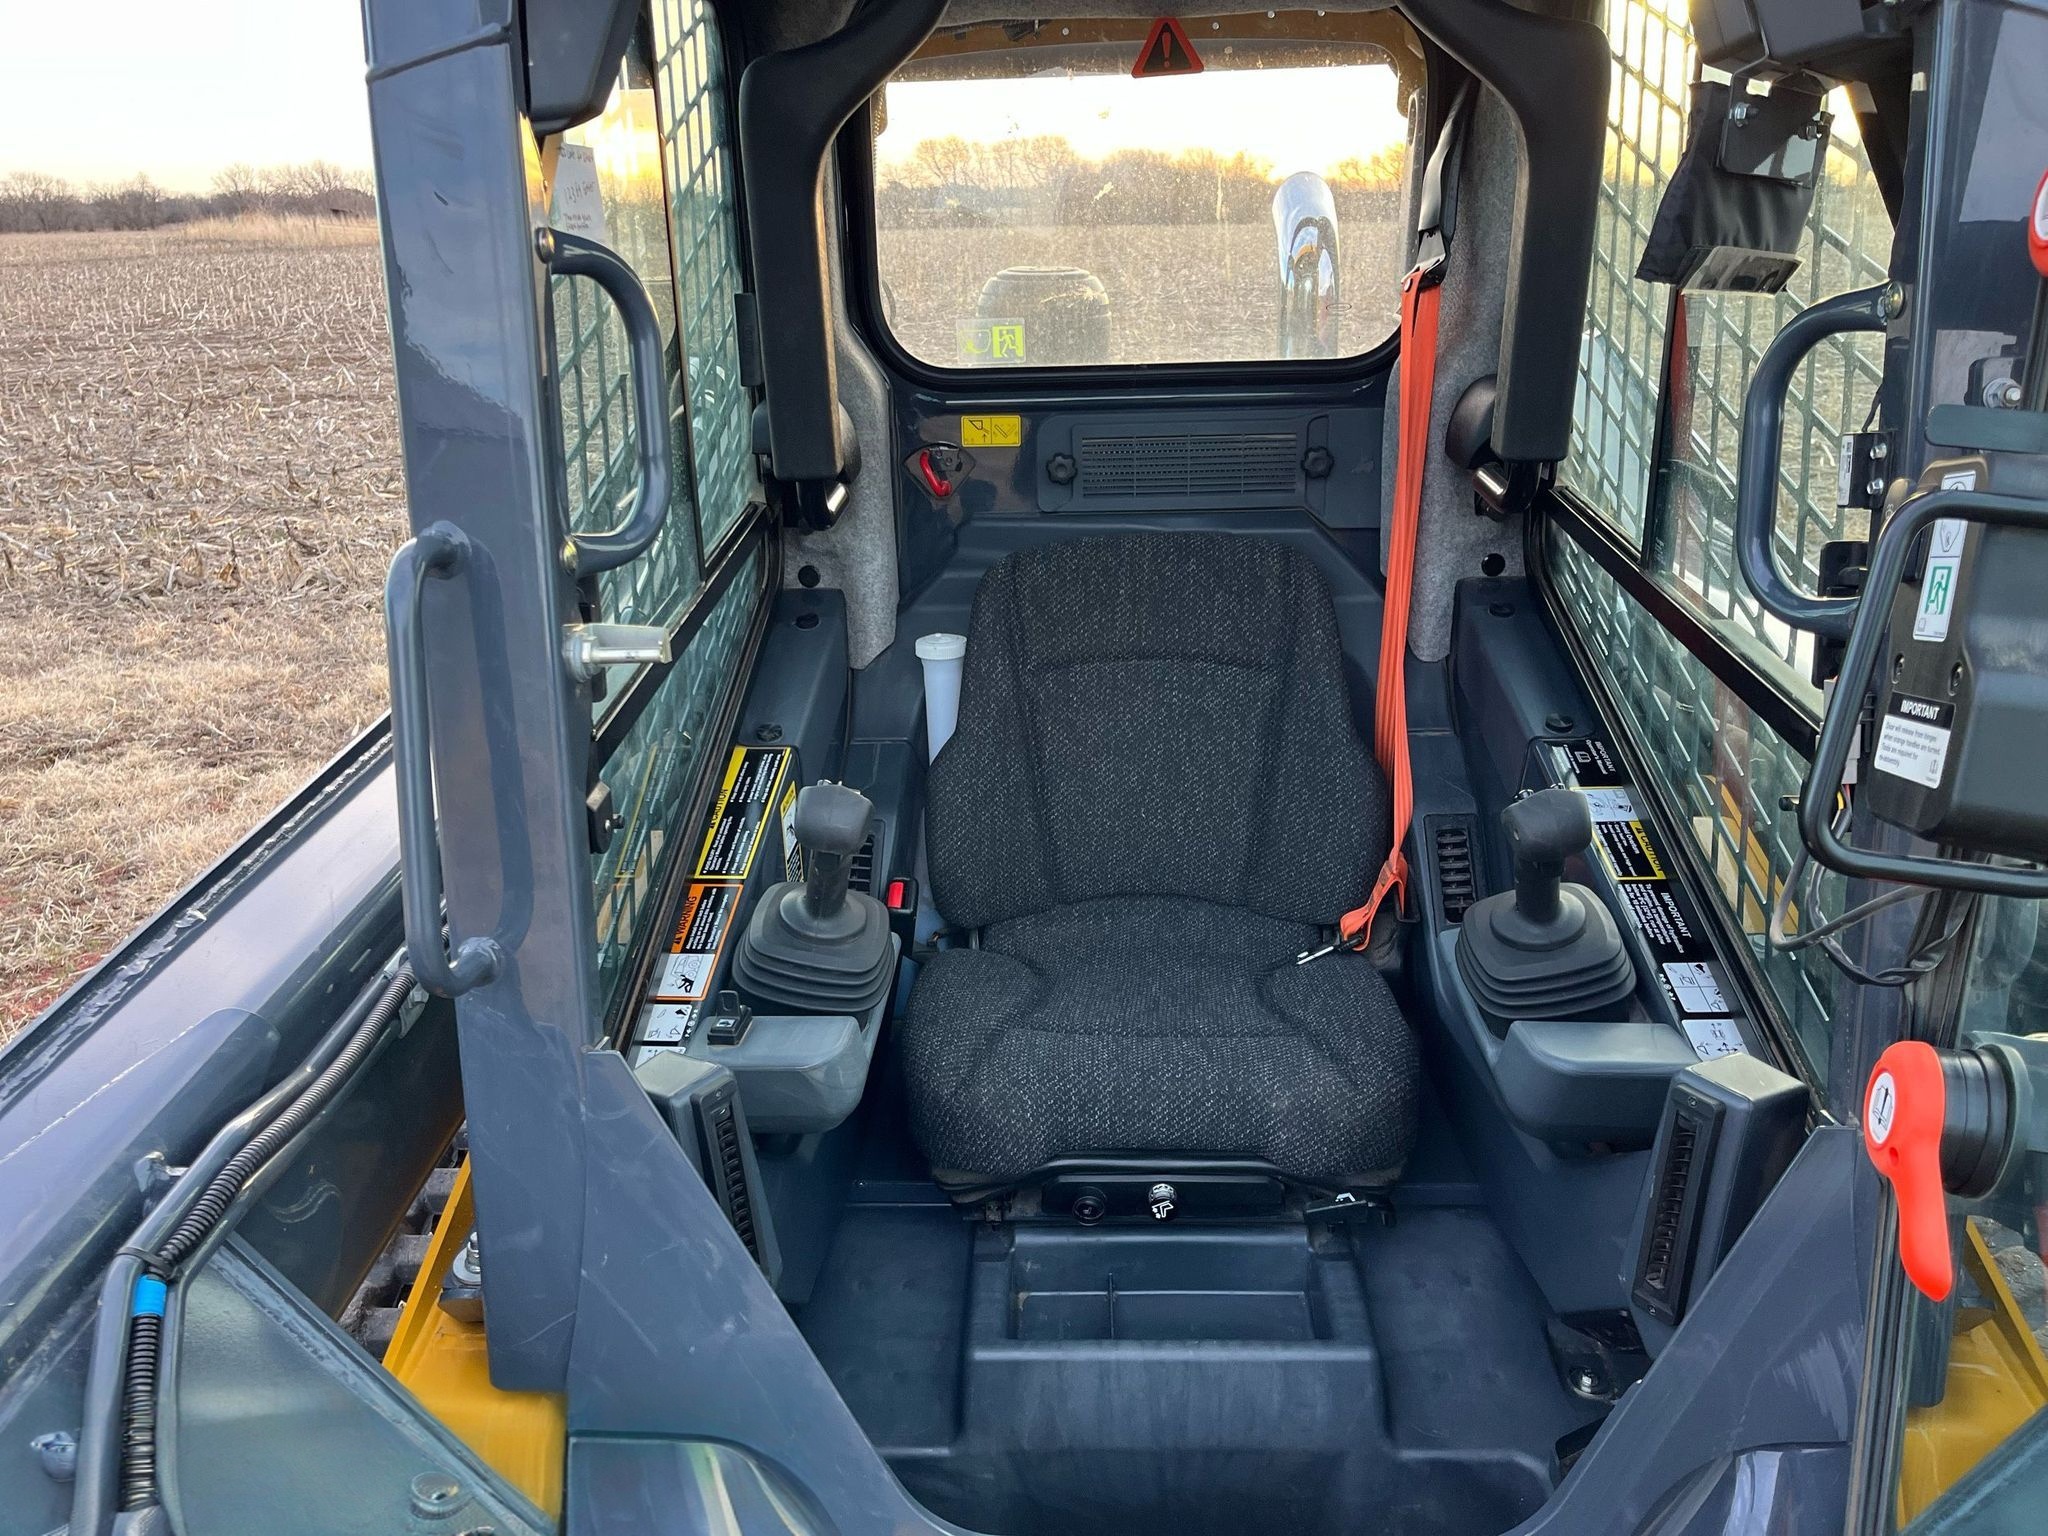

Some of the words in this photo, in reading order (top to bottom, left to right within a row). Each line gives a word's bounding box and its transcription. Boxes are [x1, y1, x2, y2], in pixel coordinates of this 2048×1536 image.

[1900, 699, 1941, 720] IMPORTANT
[1595, 741, 1616, 773] IMPORTANT
[680, 896, 697, 934] WARNING
[1661, 892, 1692, 938] IMPORTANT
